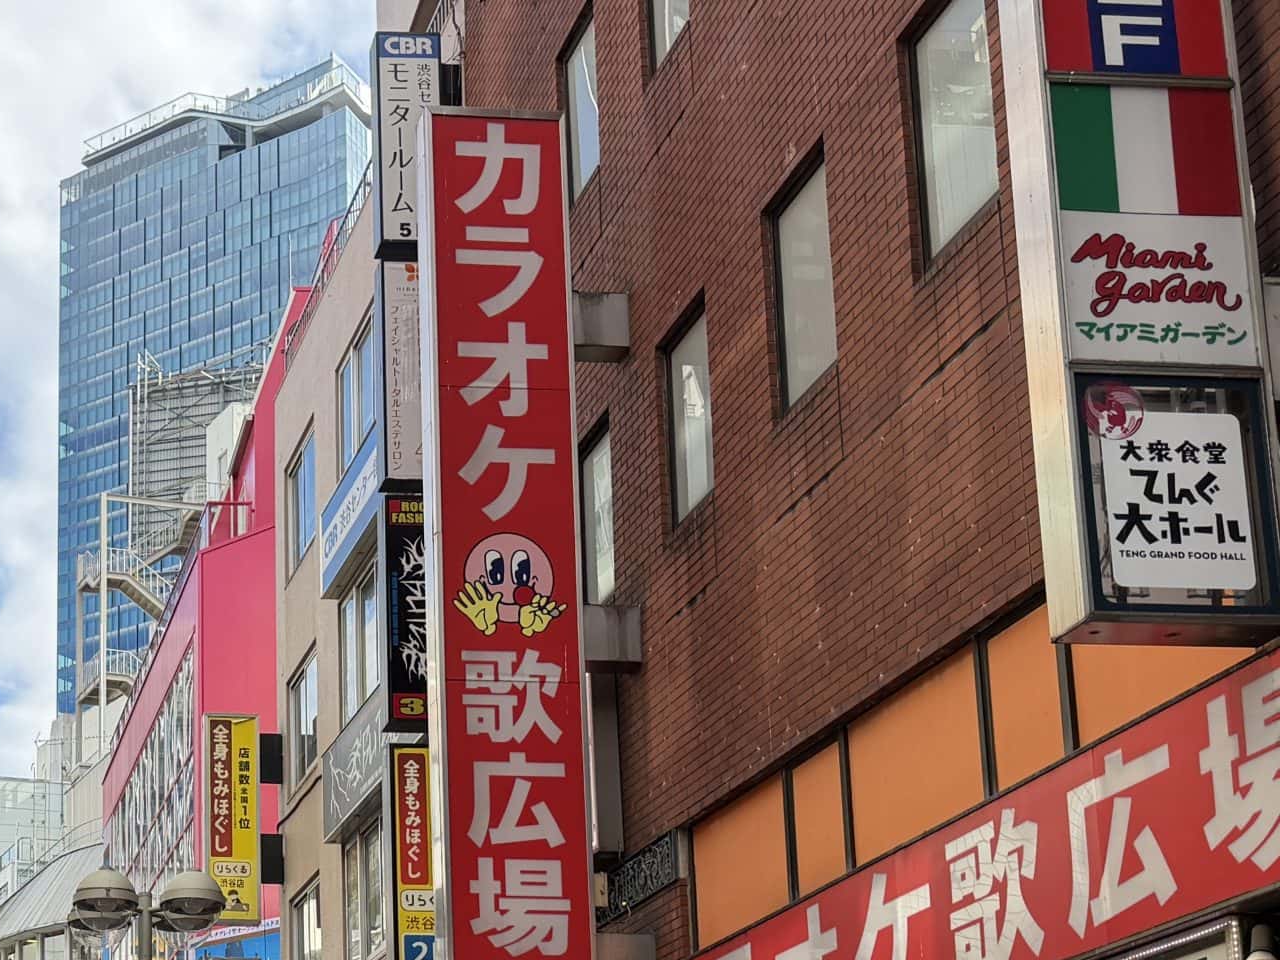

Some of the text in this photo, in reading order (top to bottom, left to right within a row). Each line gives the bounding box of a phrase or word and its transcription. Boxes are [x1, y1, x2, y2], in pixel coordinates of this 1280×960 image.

[384, 36, 433, 56] CBR
[387, 62, 414, 214] モニタールーム
[1071, 233, 1213, 270] Miami
[1075, 321, 1247, 345] マイアミガーデン
[1120, 440, 1227, 465] 大衆食堂
[1129, 468, 1221, 506] てんぐ
[454, 122, 572, 958] カラオケ 歌広場
[1113, 503, 1247, 545] 大ホール
[1119, 549, 1246, 561] TENG GRAND FOOD HALL
[212, 724, 230, 854] 全身もみほぐし
[403, 760, 421, 878] 全身もみほぐし
[215, 864, 248, 875] りらくる
[220, 878, 245, 889] 渋谷店
